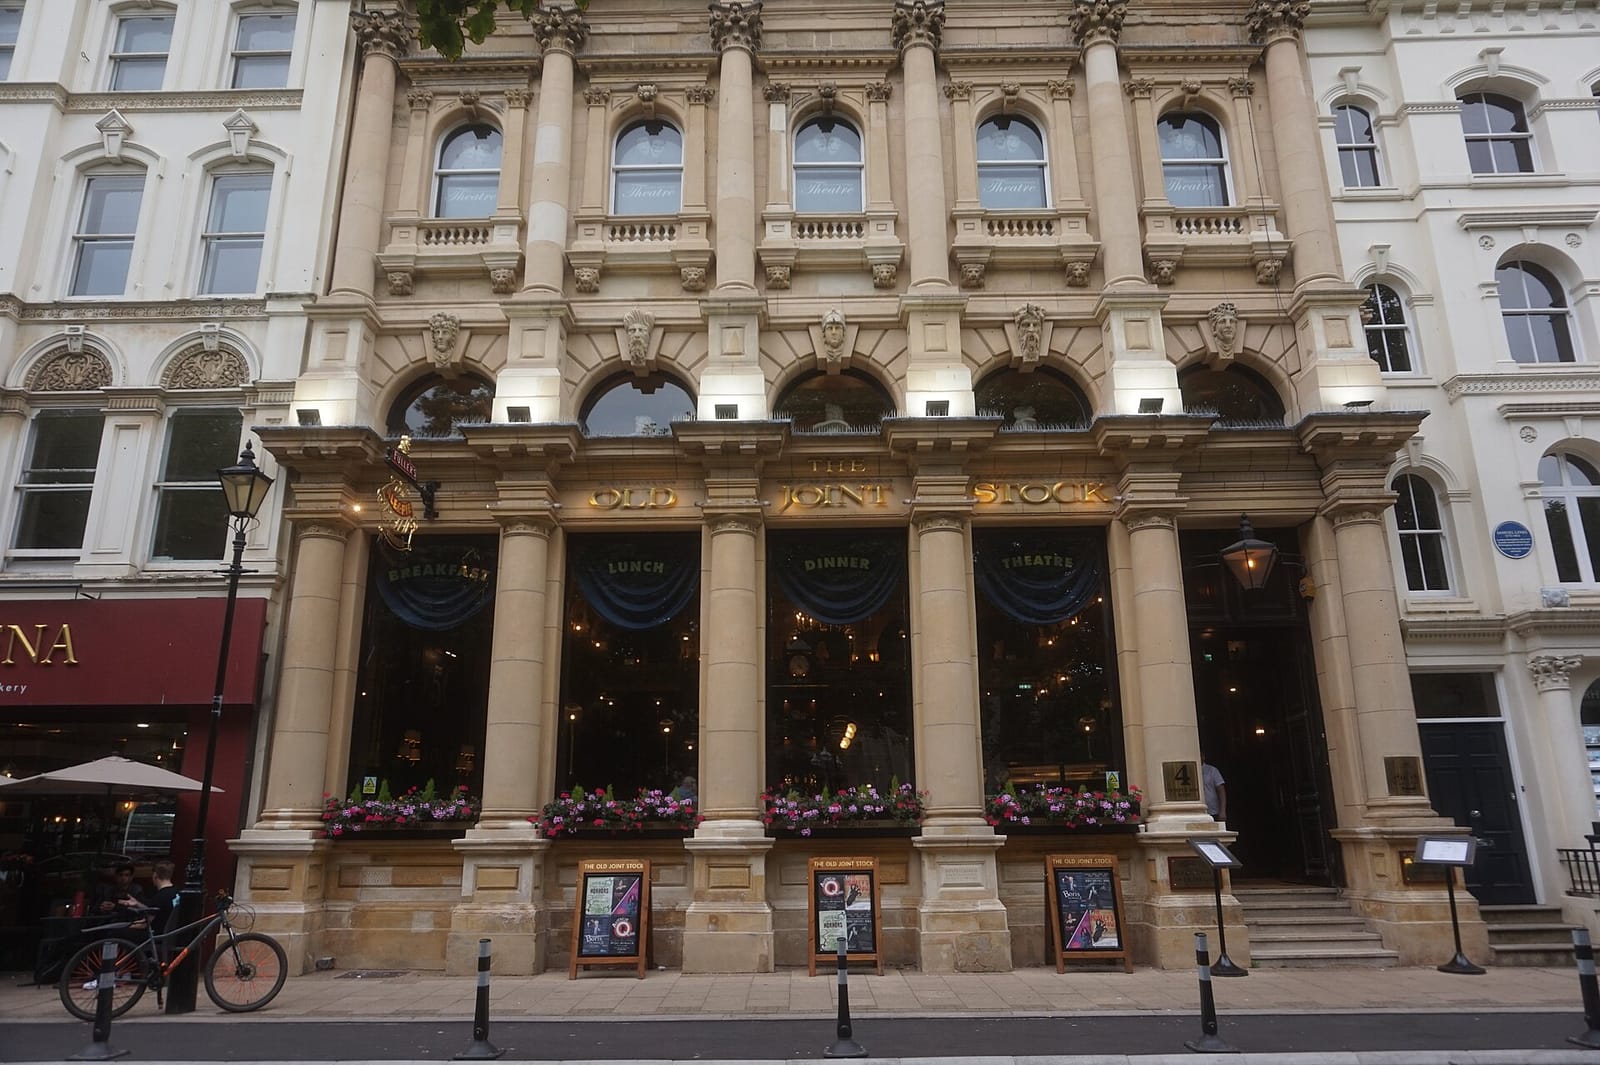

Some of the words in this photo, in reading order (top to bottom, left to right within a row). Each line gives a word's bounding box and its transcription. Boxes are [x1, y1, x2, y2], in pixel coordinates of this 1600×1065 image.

[622, 183, 674, 198] Theatre
[802, 181, 855, 195] Theatre
[984, 179, 1036, 193] Theatre
[1167, 177, 1215, 192] Theatre
[808, 458, 866, 473] THE
[588, 486, 678, 510] OLD
[781, 484, 893, 513] JOINT
[973, 481, 1110, 504] STOCK
[608, 560, 665, 574] LUNCH
[804, 556, 870, 571] DINNER
[1002, 554, 1074, 568] THEATRE
[388, 563, 491, 582] BREAKFAST
[0, 624, 79, 664] NA
[1175, 764, 1190, 786] 4
